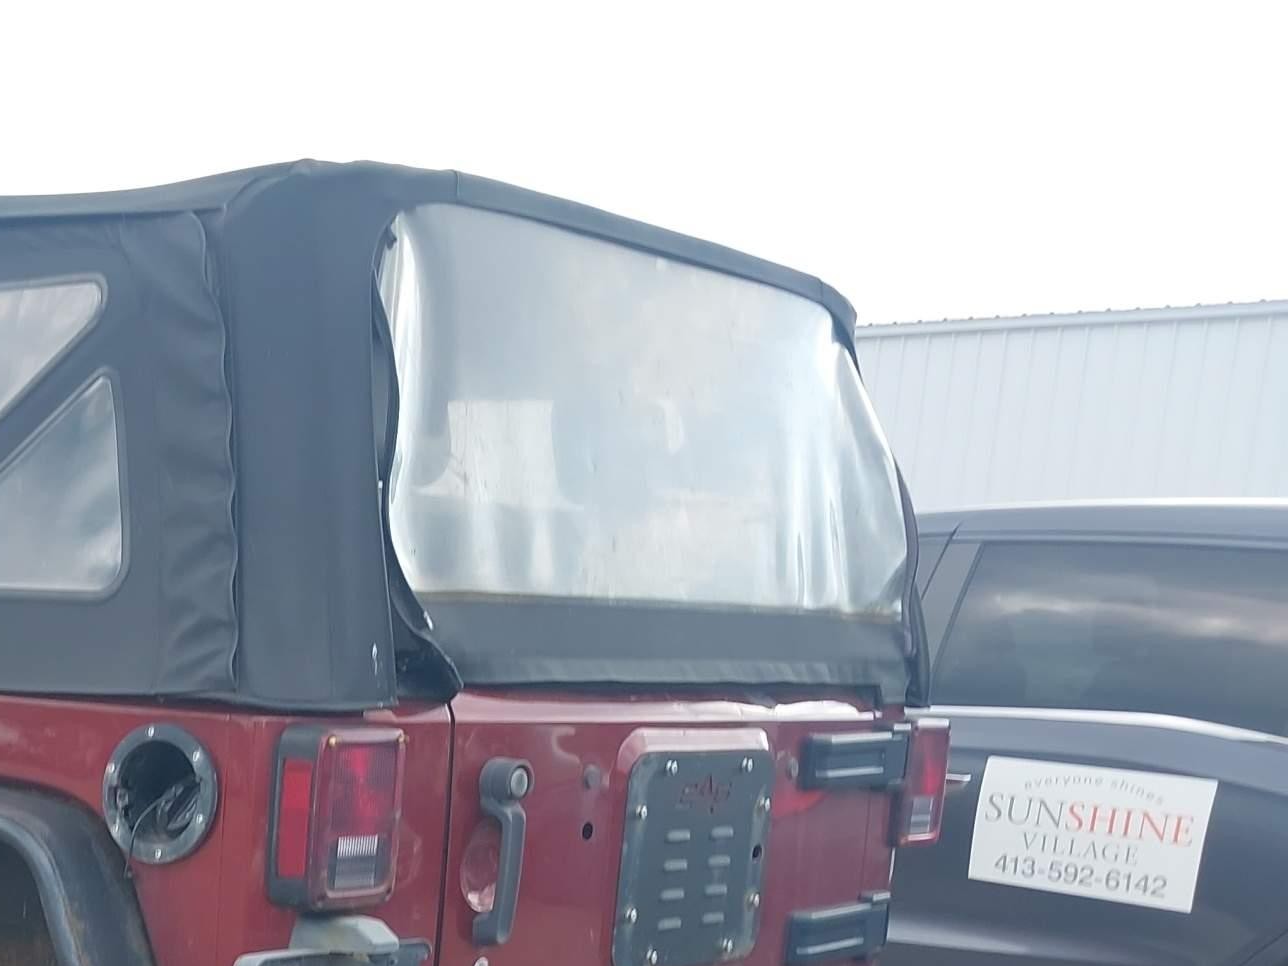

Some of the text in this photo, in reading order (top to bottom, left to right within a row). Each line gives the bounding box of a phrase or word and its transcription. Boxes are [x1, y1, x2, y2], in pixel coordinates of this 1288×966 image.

[984, 791, 1195, 847] SUNSHINE
[1023, 832, 1139, 867] VILLAGE
[994, 853, 1168, 898] 413-592-6142
